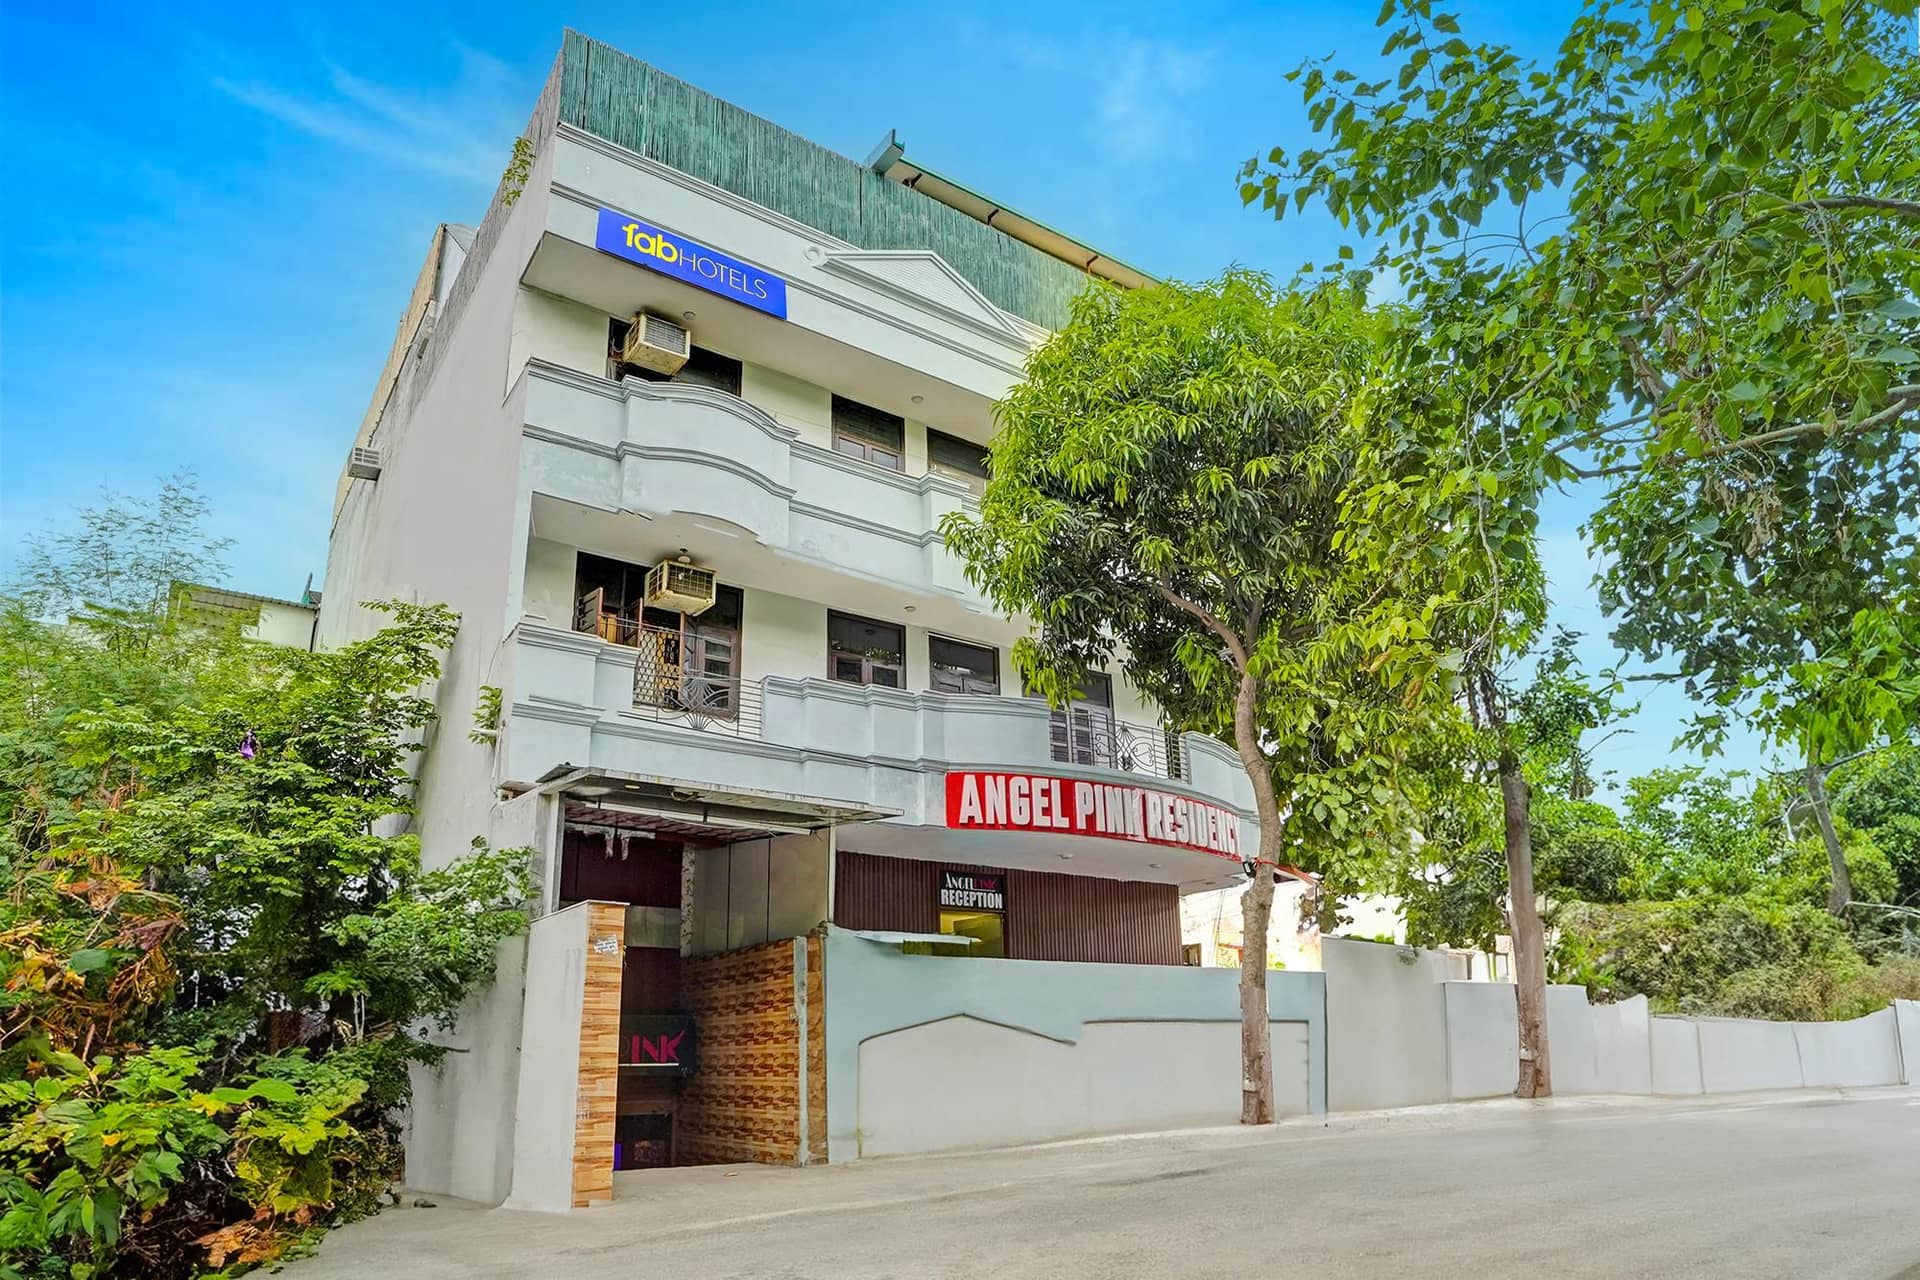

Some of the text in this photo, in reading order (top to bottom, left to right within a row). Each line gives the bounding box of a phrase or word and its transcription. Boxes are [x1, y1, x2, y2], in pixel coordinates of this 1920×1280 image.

[958, 774, 1241, 856] ANGEL PINK RESIDENCY
[940, 888, 1003, 910] RECEPTION
